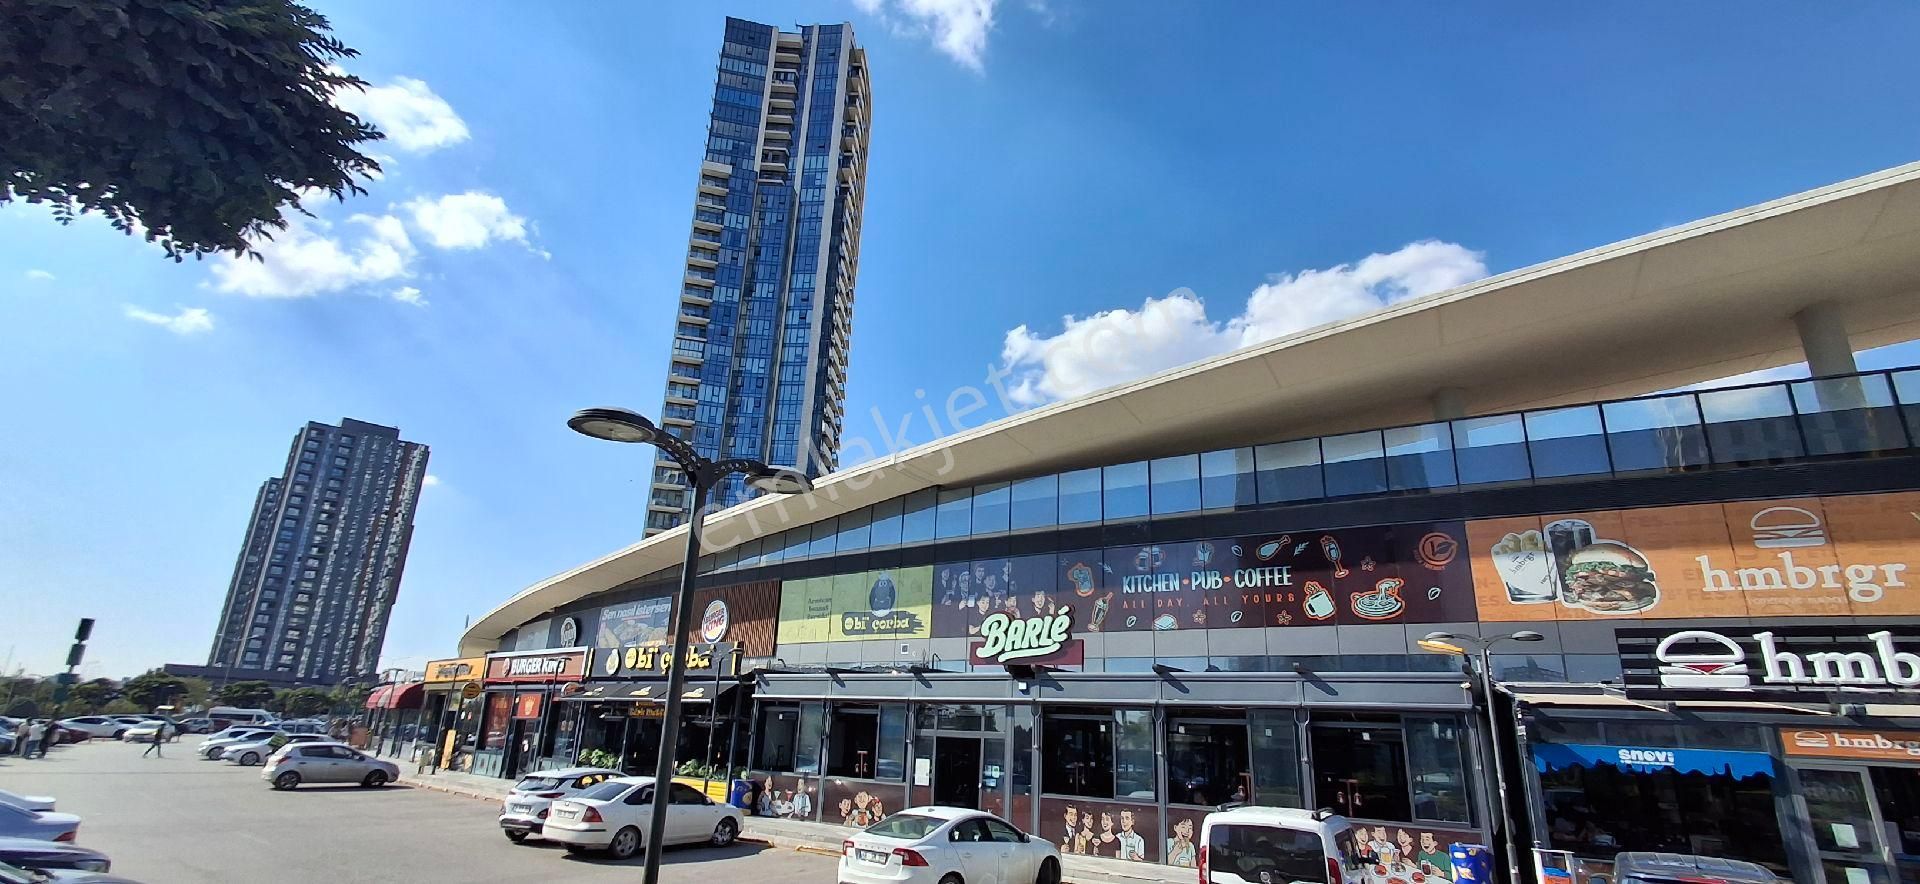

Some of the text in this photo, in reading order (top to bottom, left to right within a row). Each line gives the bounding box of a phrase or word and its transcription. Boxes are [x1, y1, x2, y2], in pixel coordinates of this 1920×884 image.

[1121, 565, 1293, 594] KITCHEN PUB COFFEE
[1695, 551, 1907, 603] hmbrgr
[1121, 600, 1147, 609] ALL
[1203, 595, 1230, 606] ALL
[1241, 592, 1296, 605] YOURS
[602, 608, 617, 620] Sen
[704, 608, 725, 624] BURGER
[703, 615, 725, 632] KING
[872, 614, 910, 633] çorba
[511, 657, 542, 675] BURGER
[1752, 630, 1920, 687] hmb
[1618, 748, 1675, 763] snovi
